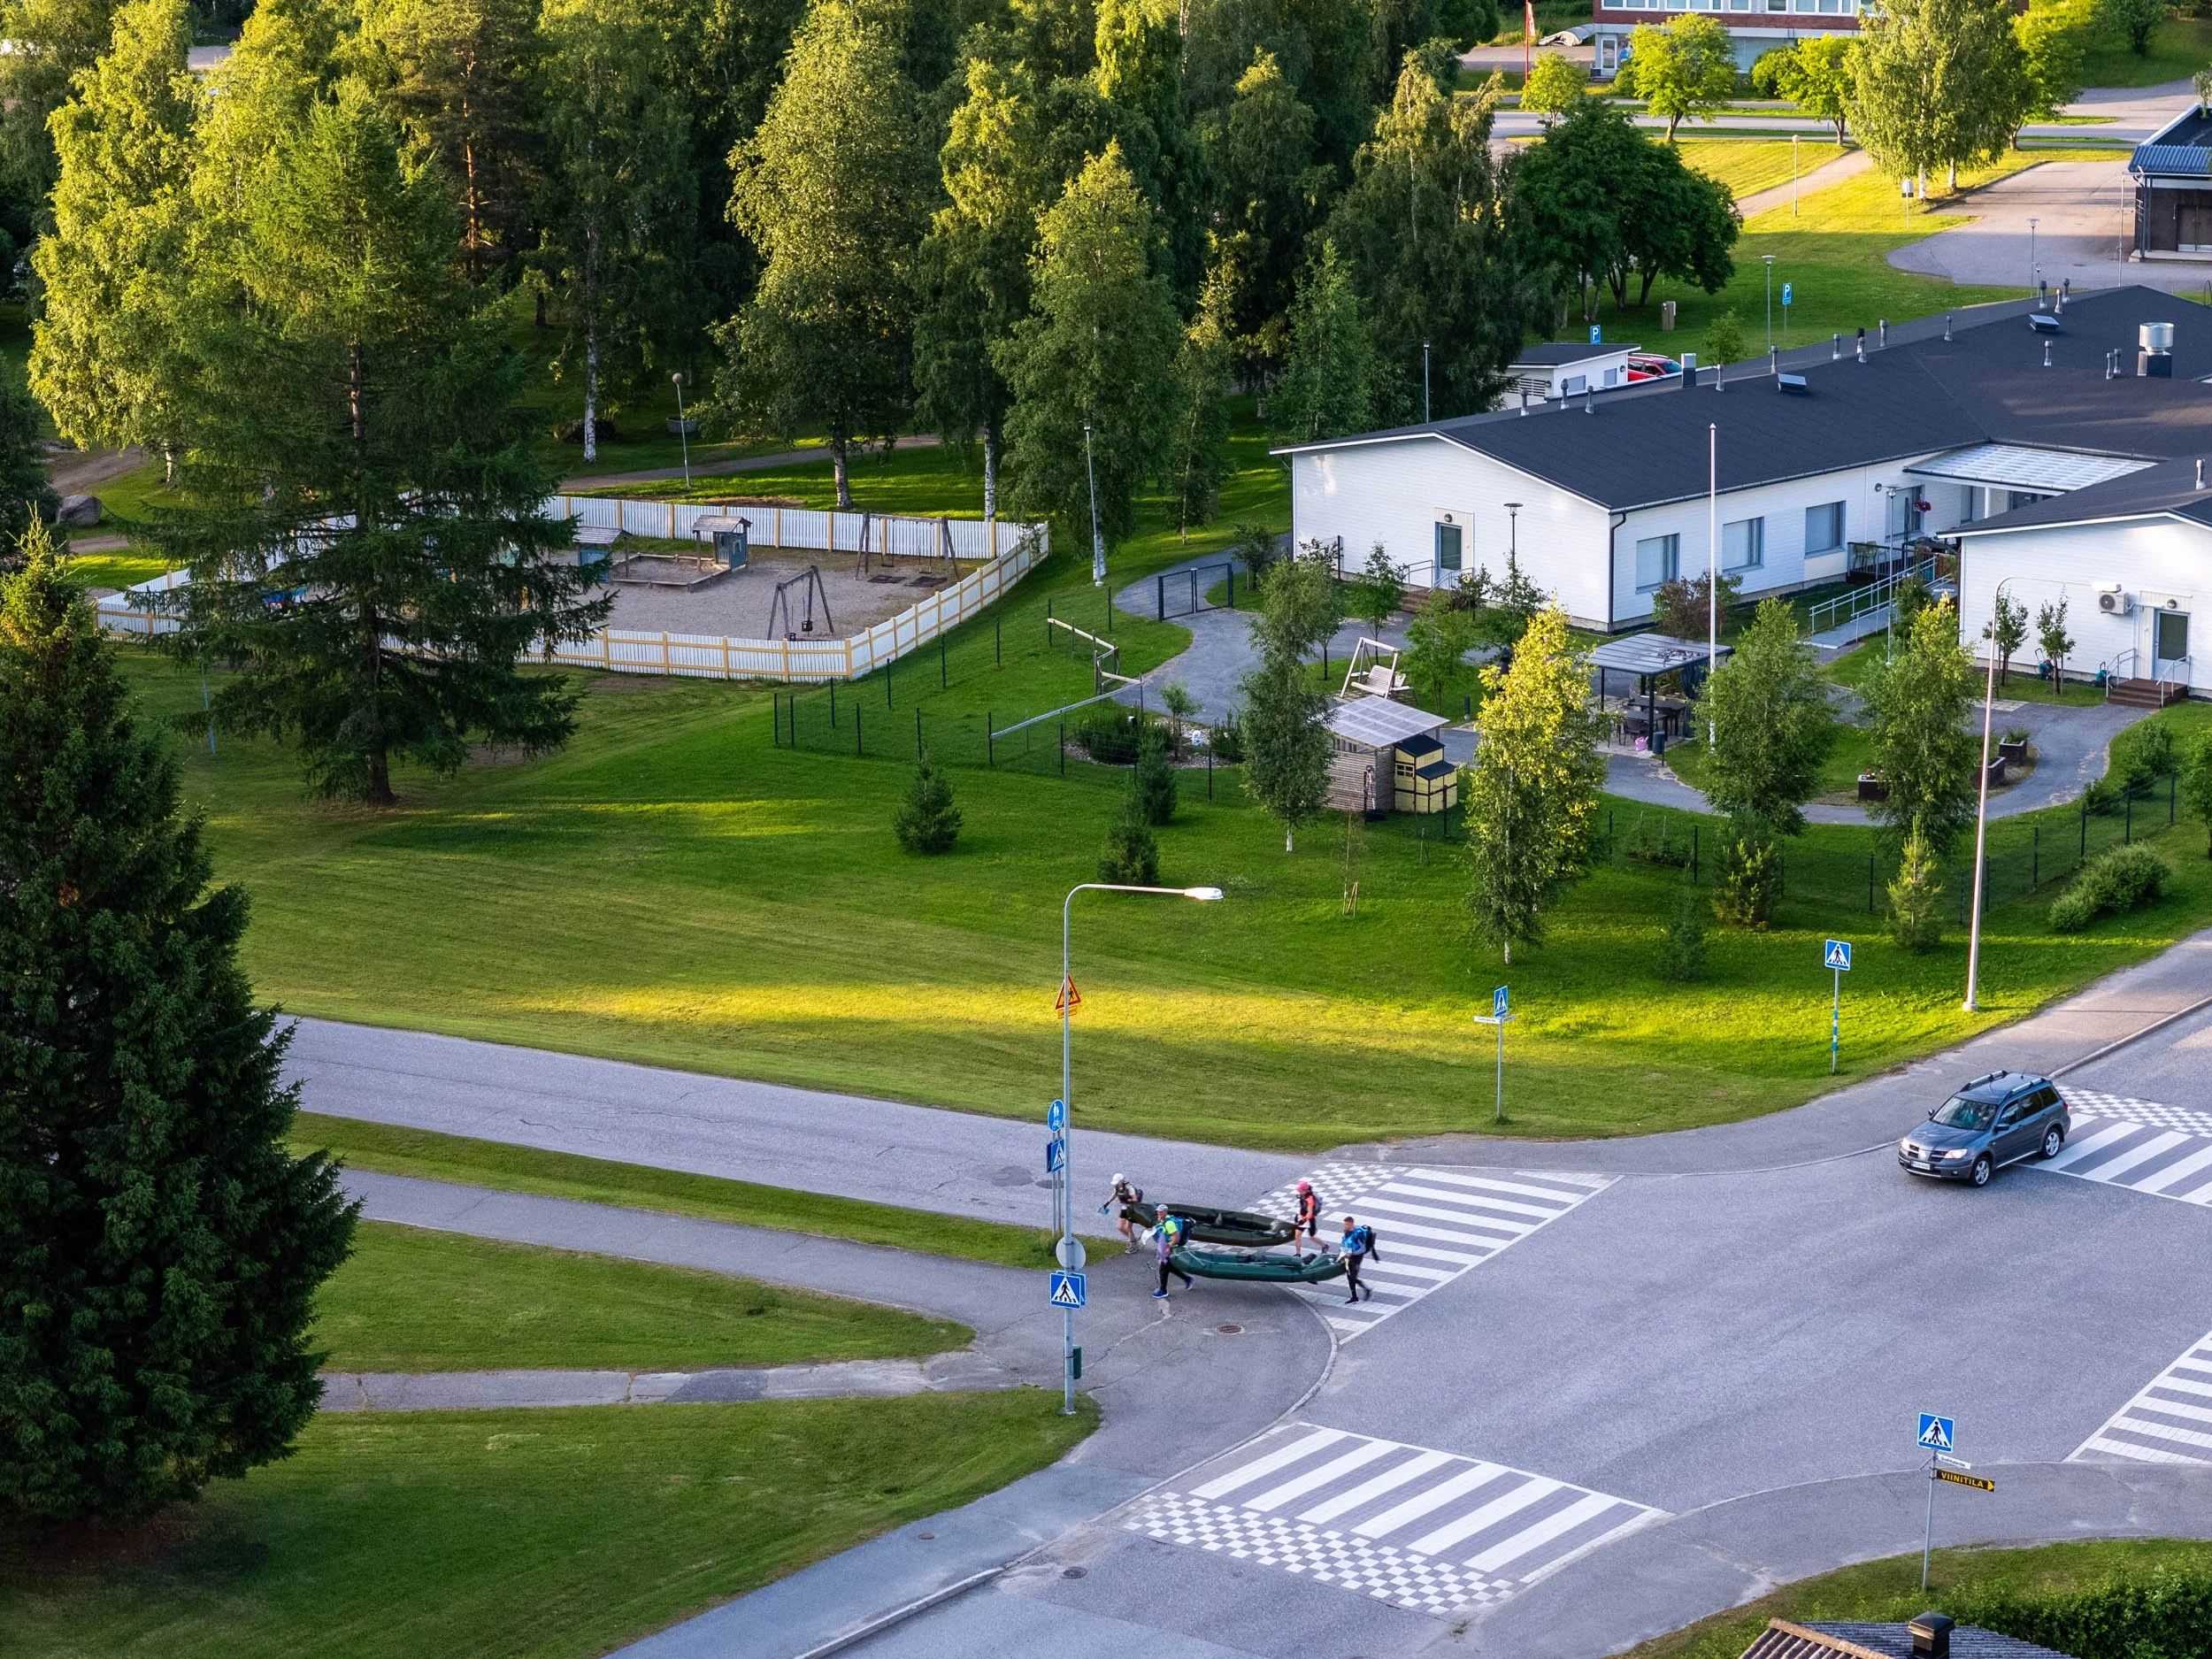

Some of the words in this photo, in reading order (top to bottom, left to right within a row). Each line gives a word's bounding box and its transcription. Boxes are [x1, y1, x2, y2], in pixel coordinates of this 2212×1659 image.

[1785, 284, 1791, 297] P
[1593, 326, 1599, 341] P
[1941, 1471, 1983, 1487] VIINITILA
